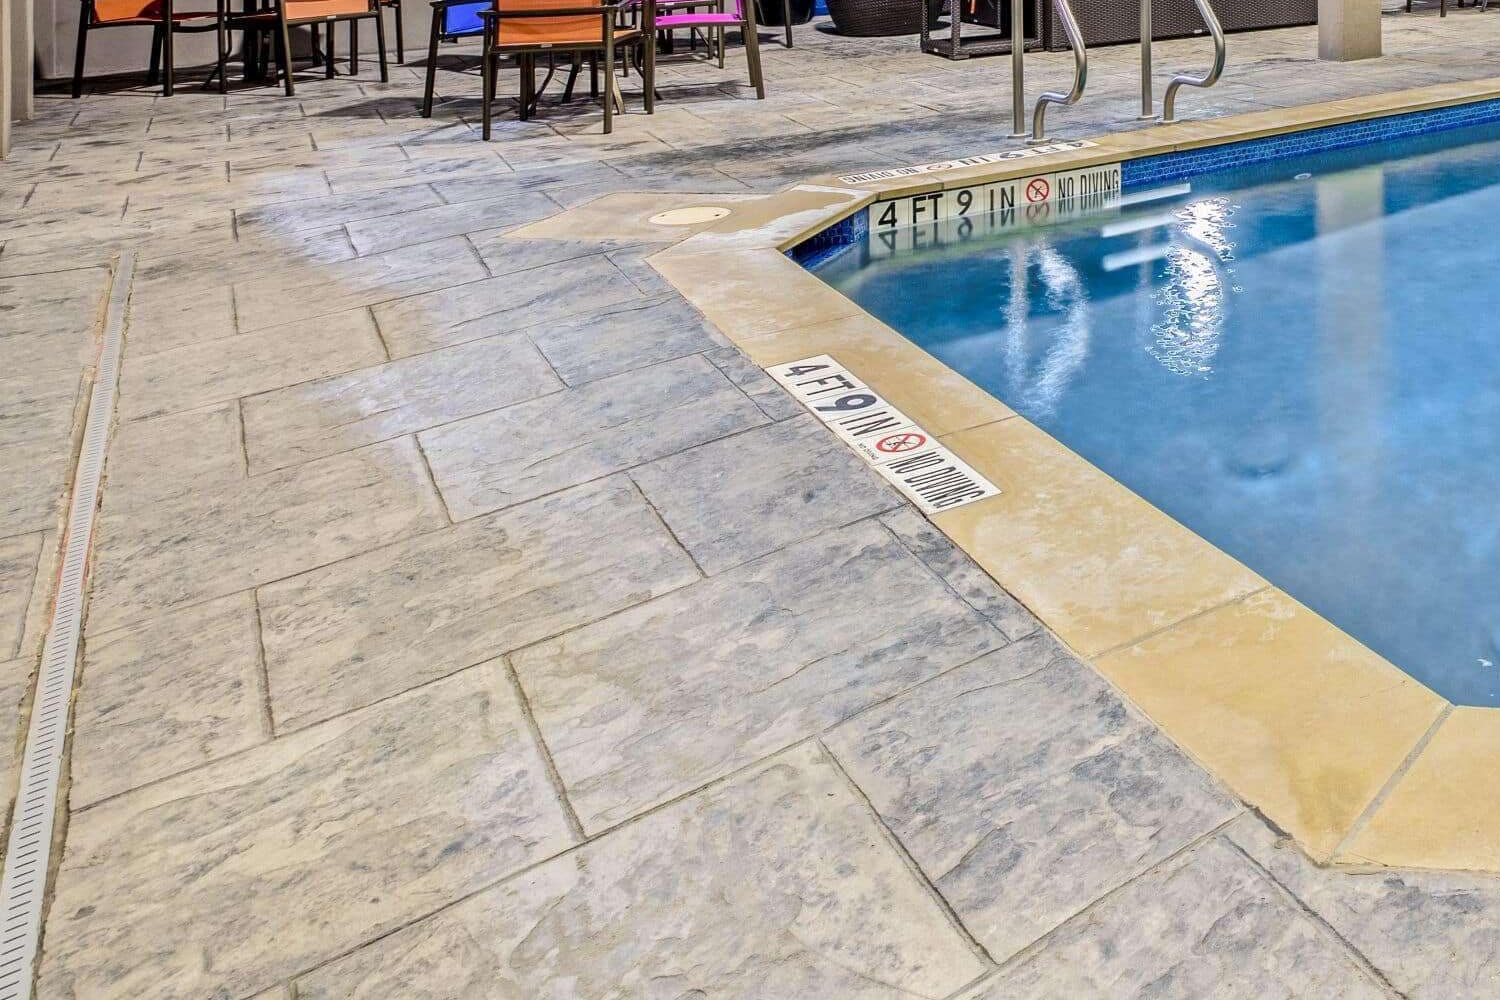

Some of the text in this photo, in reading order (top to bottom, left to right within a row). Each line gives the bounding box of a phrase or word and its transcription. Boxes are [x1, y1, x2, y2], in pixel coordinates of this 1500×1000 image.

[898, 167, 918, 175] NO
[958, 157, 991, 165] IN
[842, 171, 892, 183] DIVING
[878, 169, 1119, 228] 4 FT 9 IN NO DIVING
[784, 364, 831, 377] 4
[796, 374, 856, 396] FT
[814, 393, 877, 412] 9
[839, 411, 901, 437] IN
[886, 451, 945, 475] NO
[904, 466, 986, 509] DIVING
